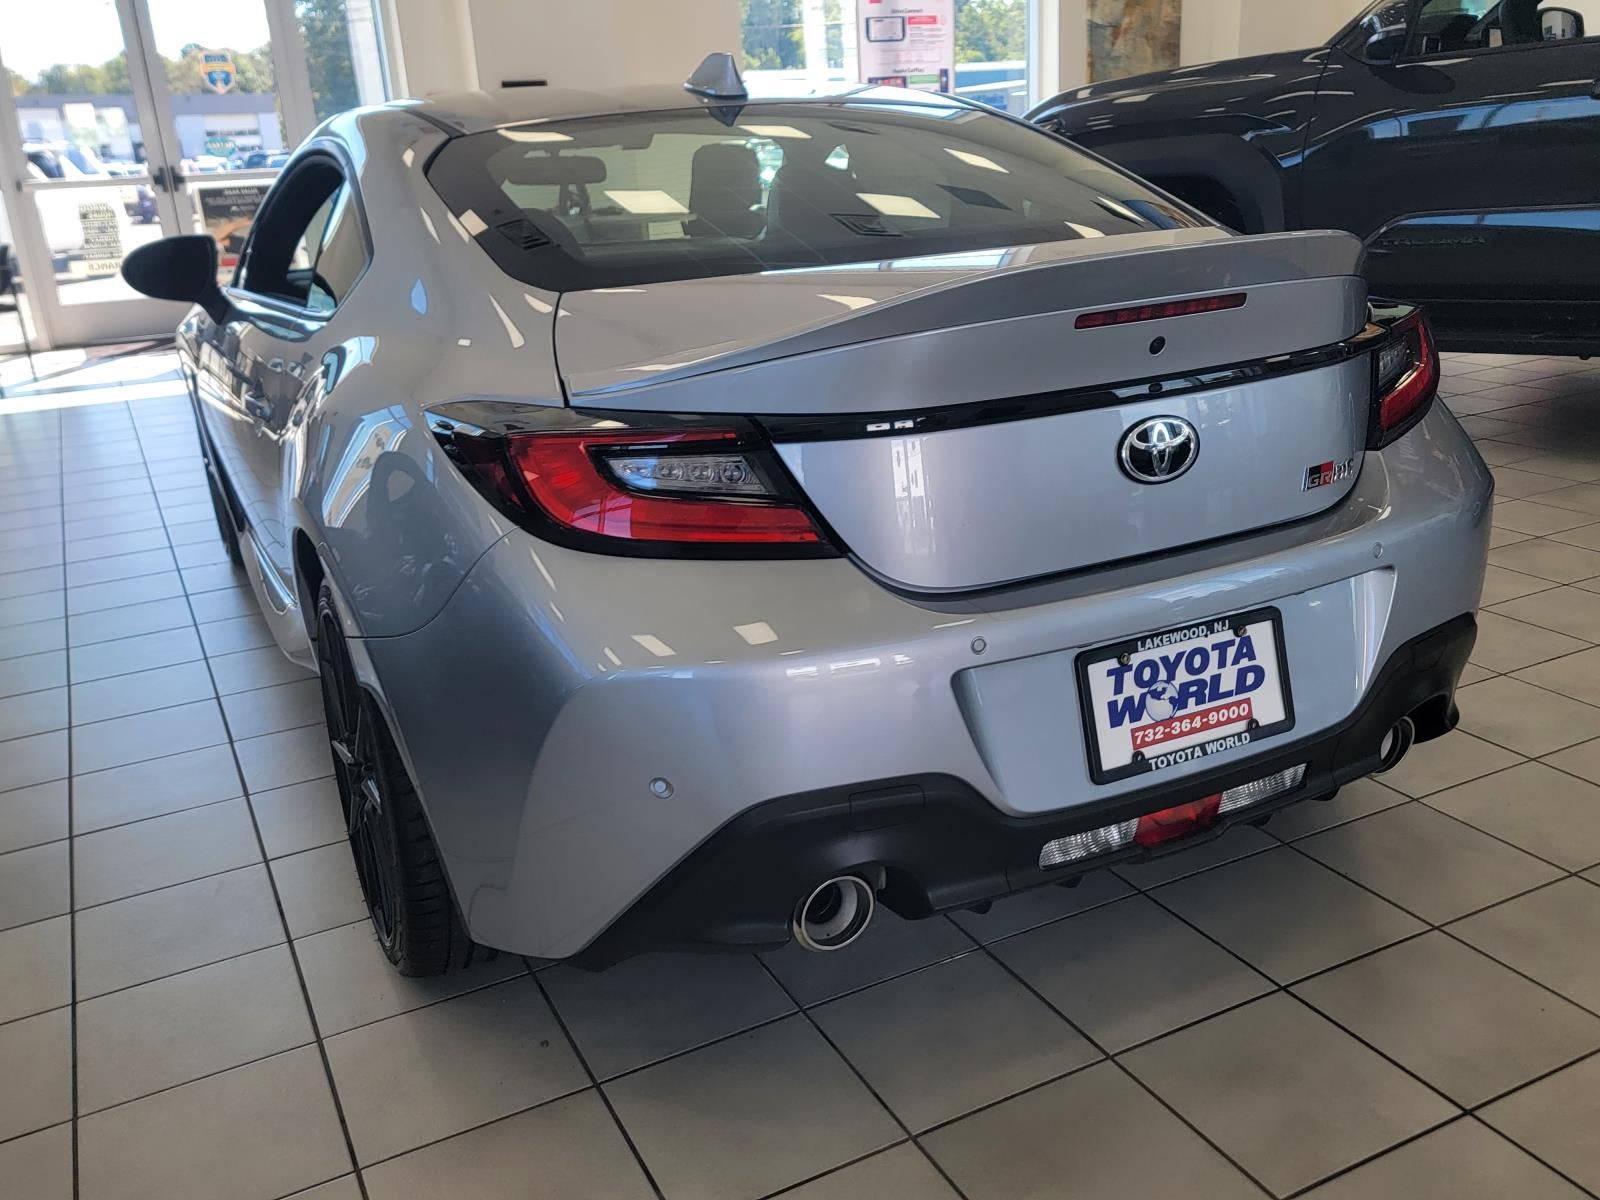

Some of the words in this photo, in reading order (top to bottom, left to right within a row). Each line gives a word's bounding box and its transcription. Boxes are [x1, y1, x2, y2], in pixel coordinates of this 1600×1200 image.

[1137, 624, 1211, 652] LAKEWOOD,
[1214, 619, 1229, 632] NJ
[1106, 635, 1257, 696] TOYOTA
[1134, 703, 1249, 745] 732-364-9000
[1149, 746, 1203, 771] TOYOTA
[1204, 732, 1251, 755] WORLD
